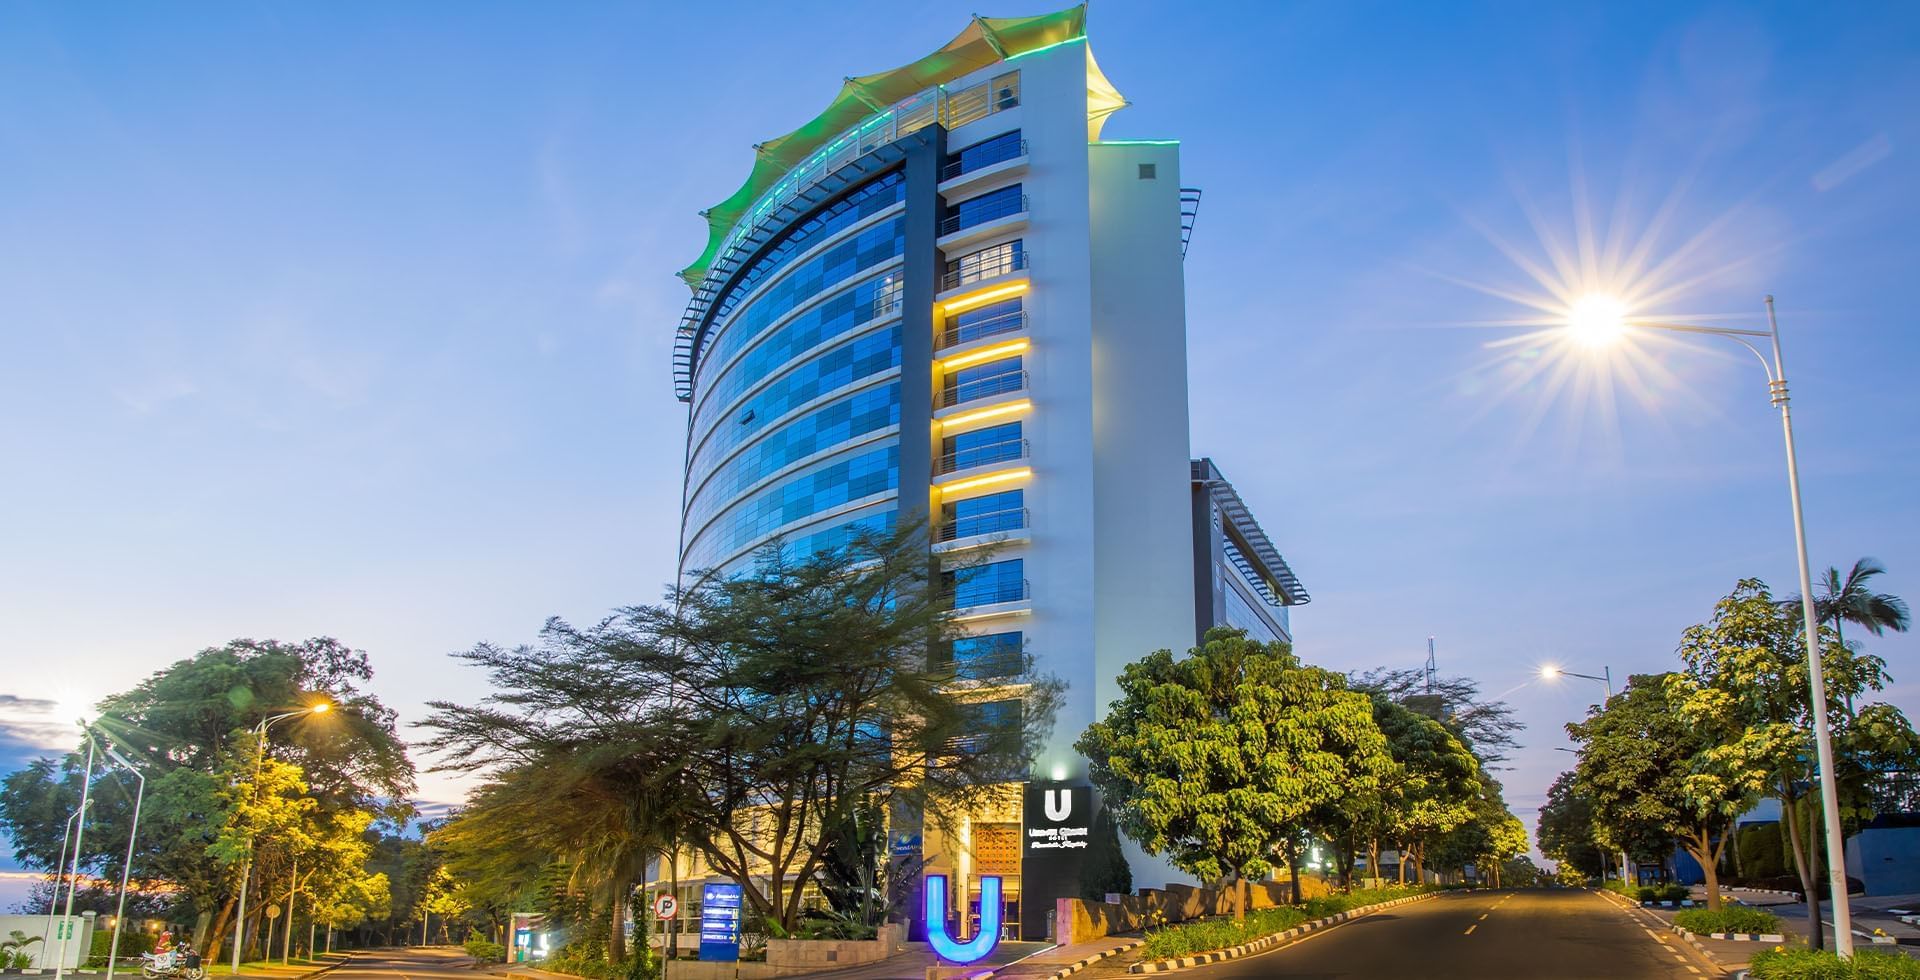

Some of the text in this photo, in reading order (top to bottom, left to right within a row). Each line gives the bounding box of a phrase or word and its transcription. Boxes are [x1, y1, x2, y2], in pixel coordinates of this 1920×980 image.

[1045, 789, 1072, 821] U
[662, 900, 672, 914] P
[927, 875, 1001, 963] U
